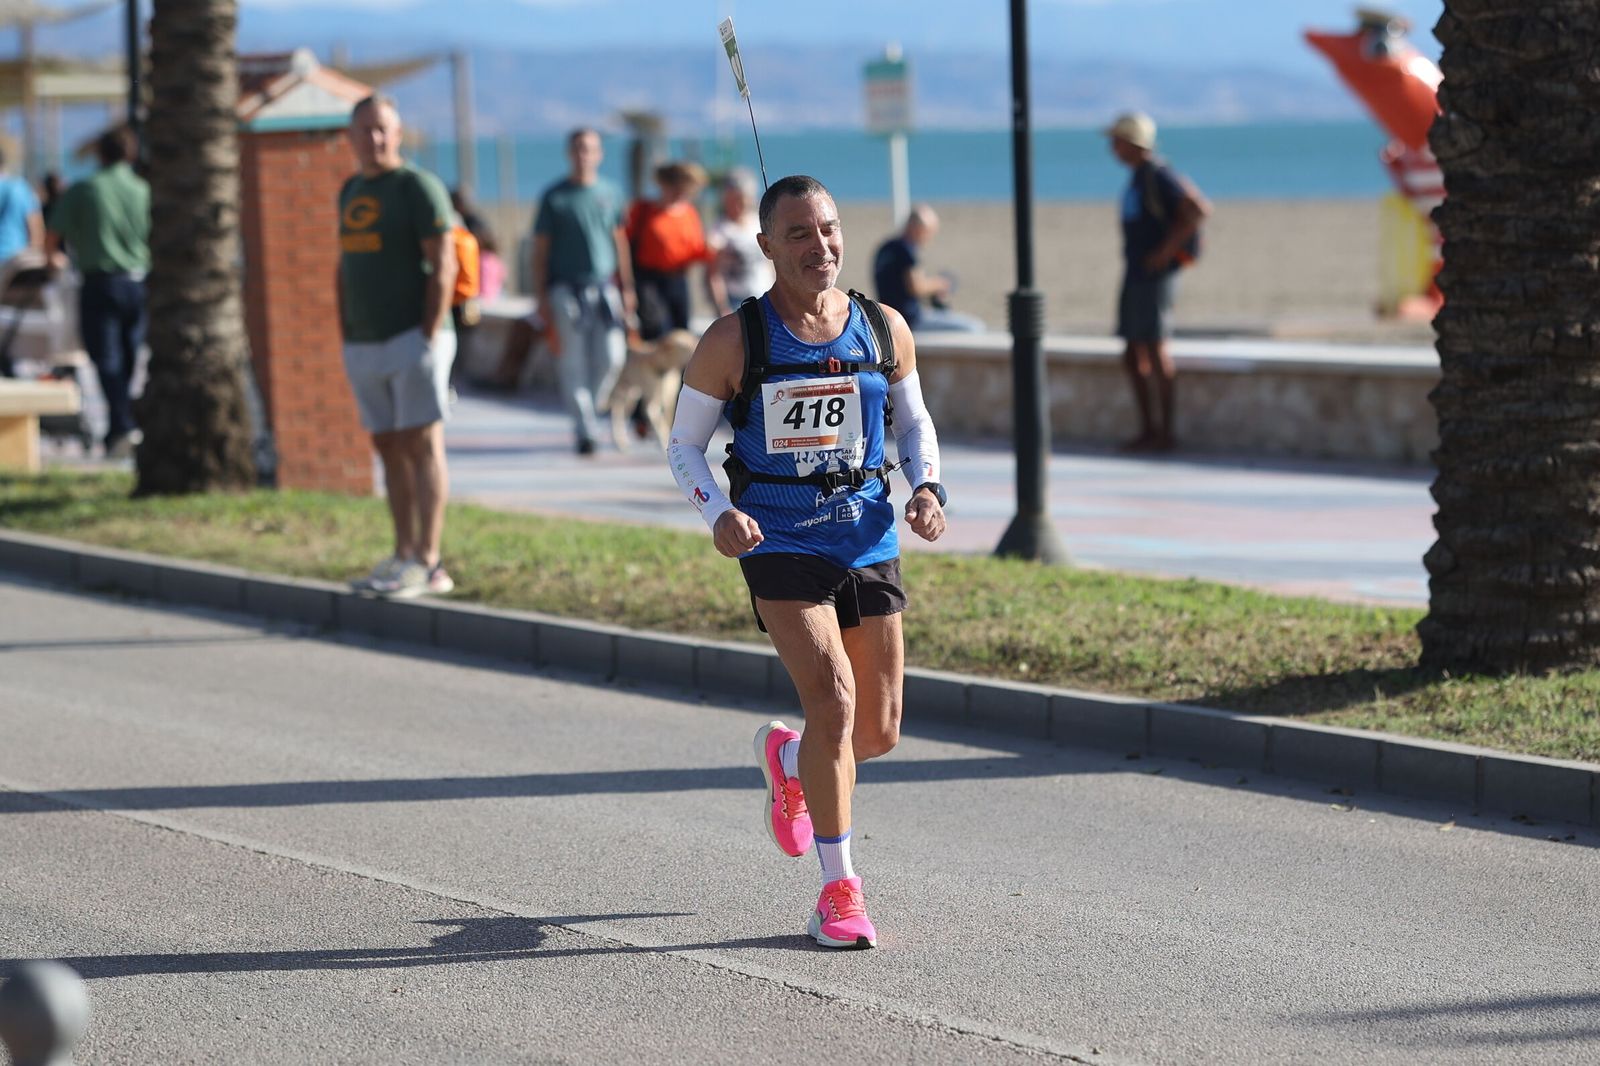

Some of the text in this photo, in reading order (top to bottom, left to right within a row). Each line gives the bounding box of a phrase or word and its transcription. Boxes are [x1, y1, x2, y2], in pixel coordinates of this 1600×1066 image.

[783, 397, 846, 430] 418
[773, 439, 789, 448] 024
[794, 511, 832, 528] mayoral
